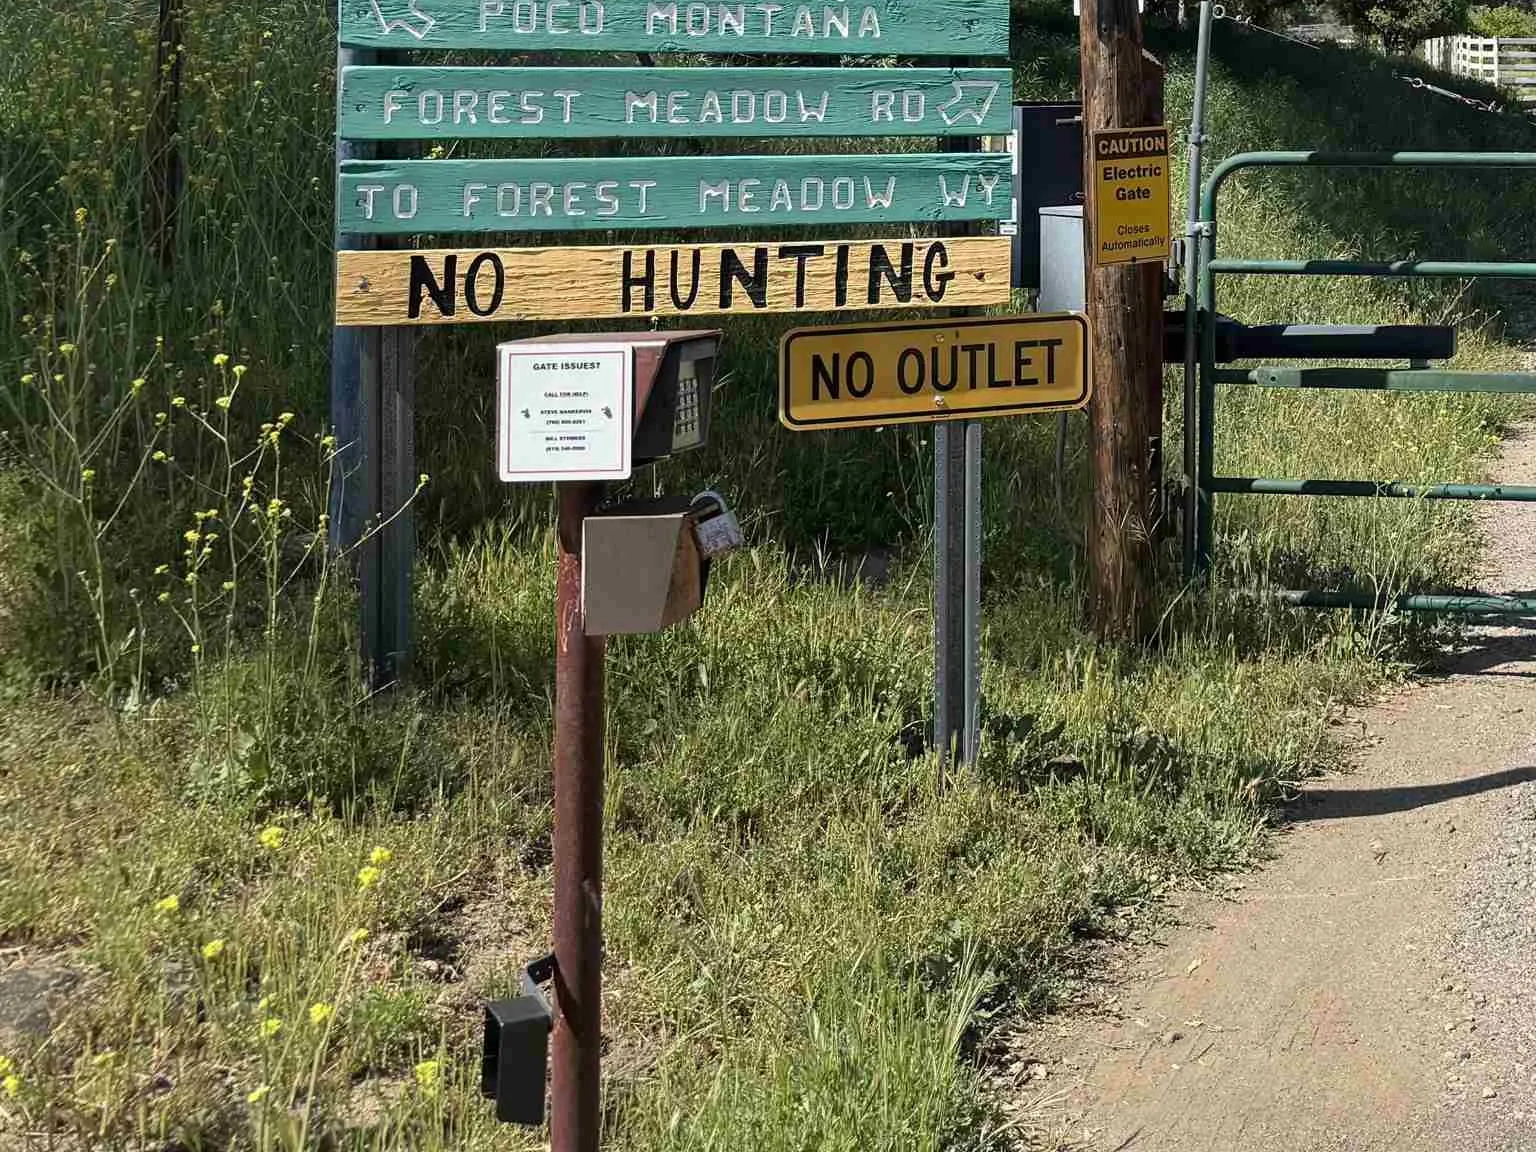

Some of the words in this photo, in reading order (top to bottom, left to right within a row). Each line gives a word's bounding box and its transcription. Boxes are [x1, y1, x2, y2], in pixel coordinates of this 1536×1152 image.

[383, 89, 585, 125] FOREST
[624, 89, 829, 124] MEADOW
[872, 90, 925, 122] RD
[1098, 136, 1165, 155] CAUTION
[1103, 164, 1162, 181] Electric
[356, 184, 418, 219] TO
[463, 181, 657, 217] FOREST
[699, 175, 896, 213] MEADOW
[939, 174, 1000, 207] WY
[1115, 186, 1151, 201] Gate
[1117, 223, 1151, 236] Closes
[1102, 236, 1165, 251] Automatically
[408, 252, 505, 319] NO
[621, 241, 955, 313] HUNTING
[532, 362, 558, 370] GATE
[811, 351, 874, 401] NO
[897, 338, 1063, 395] OUTLET
